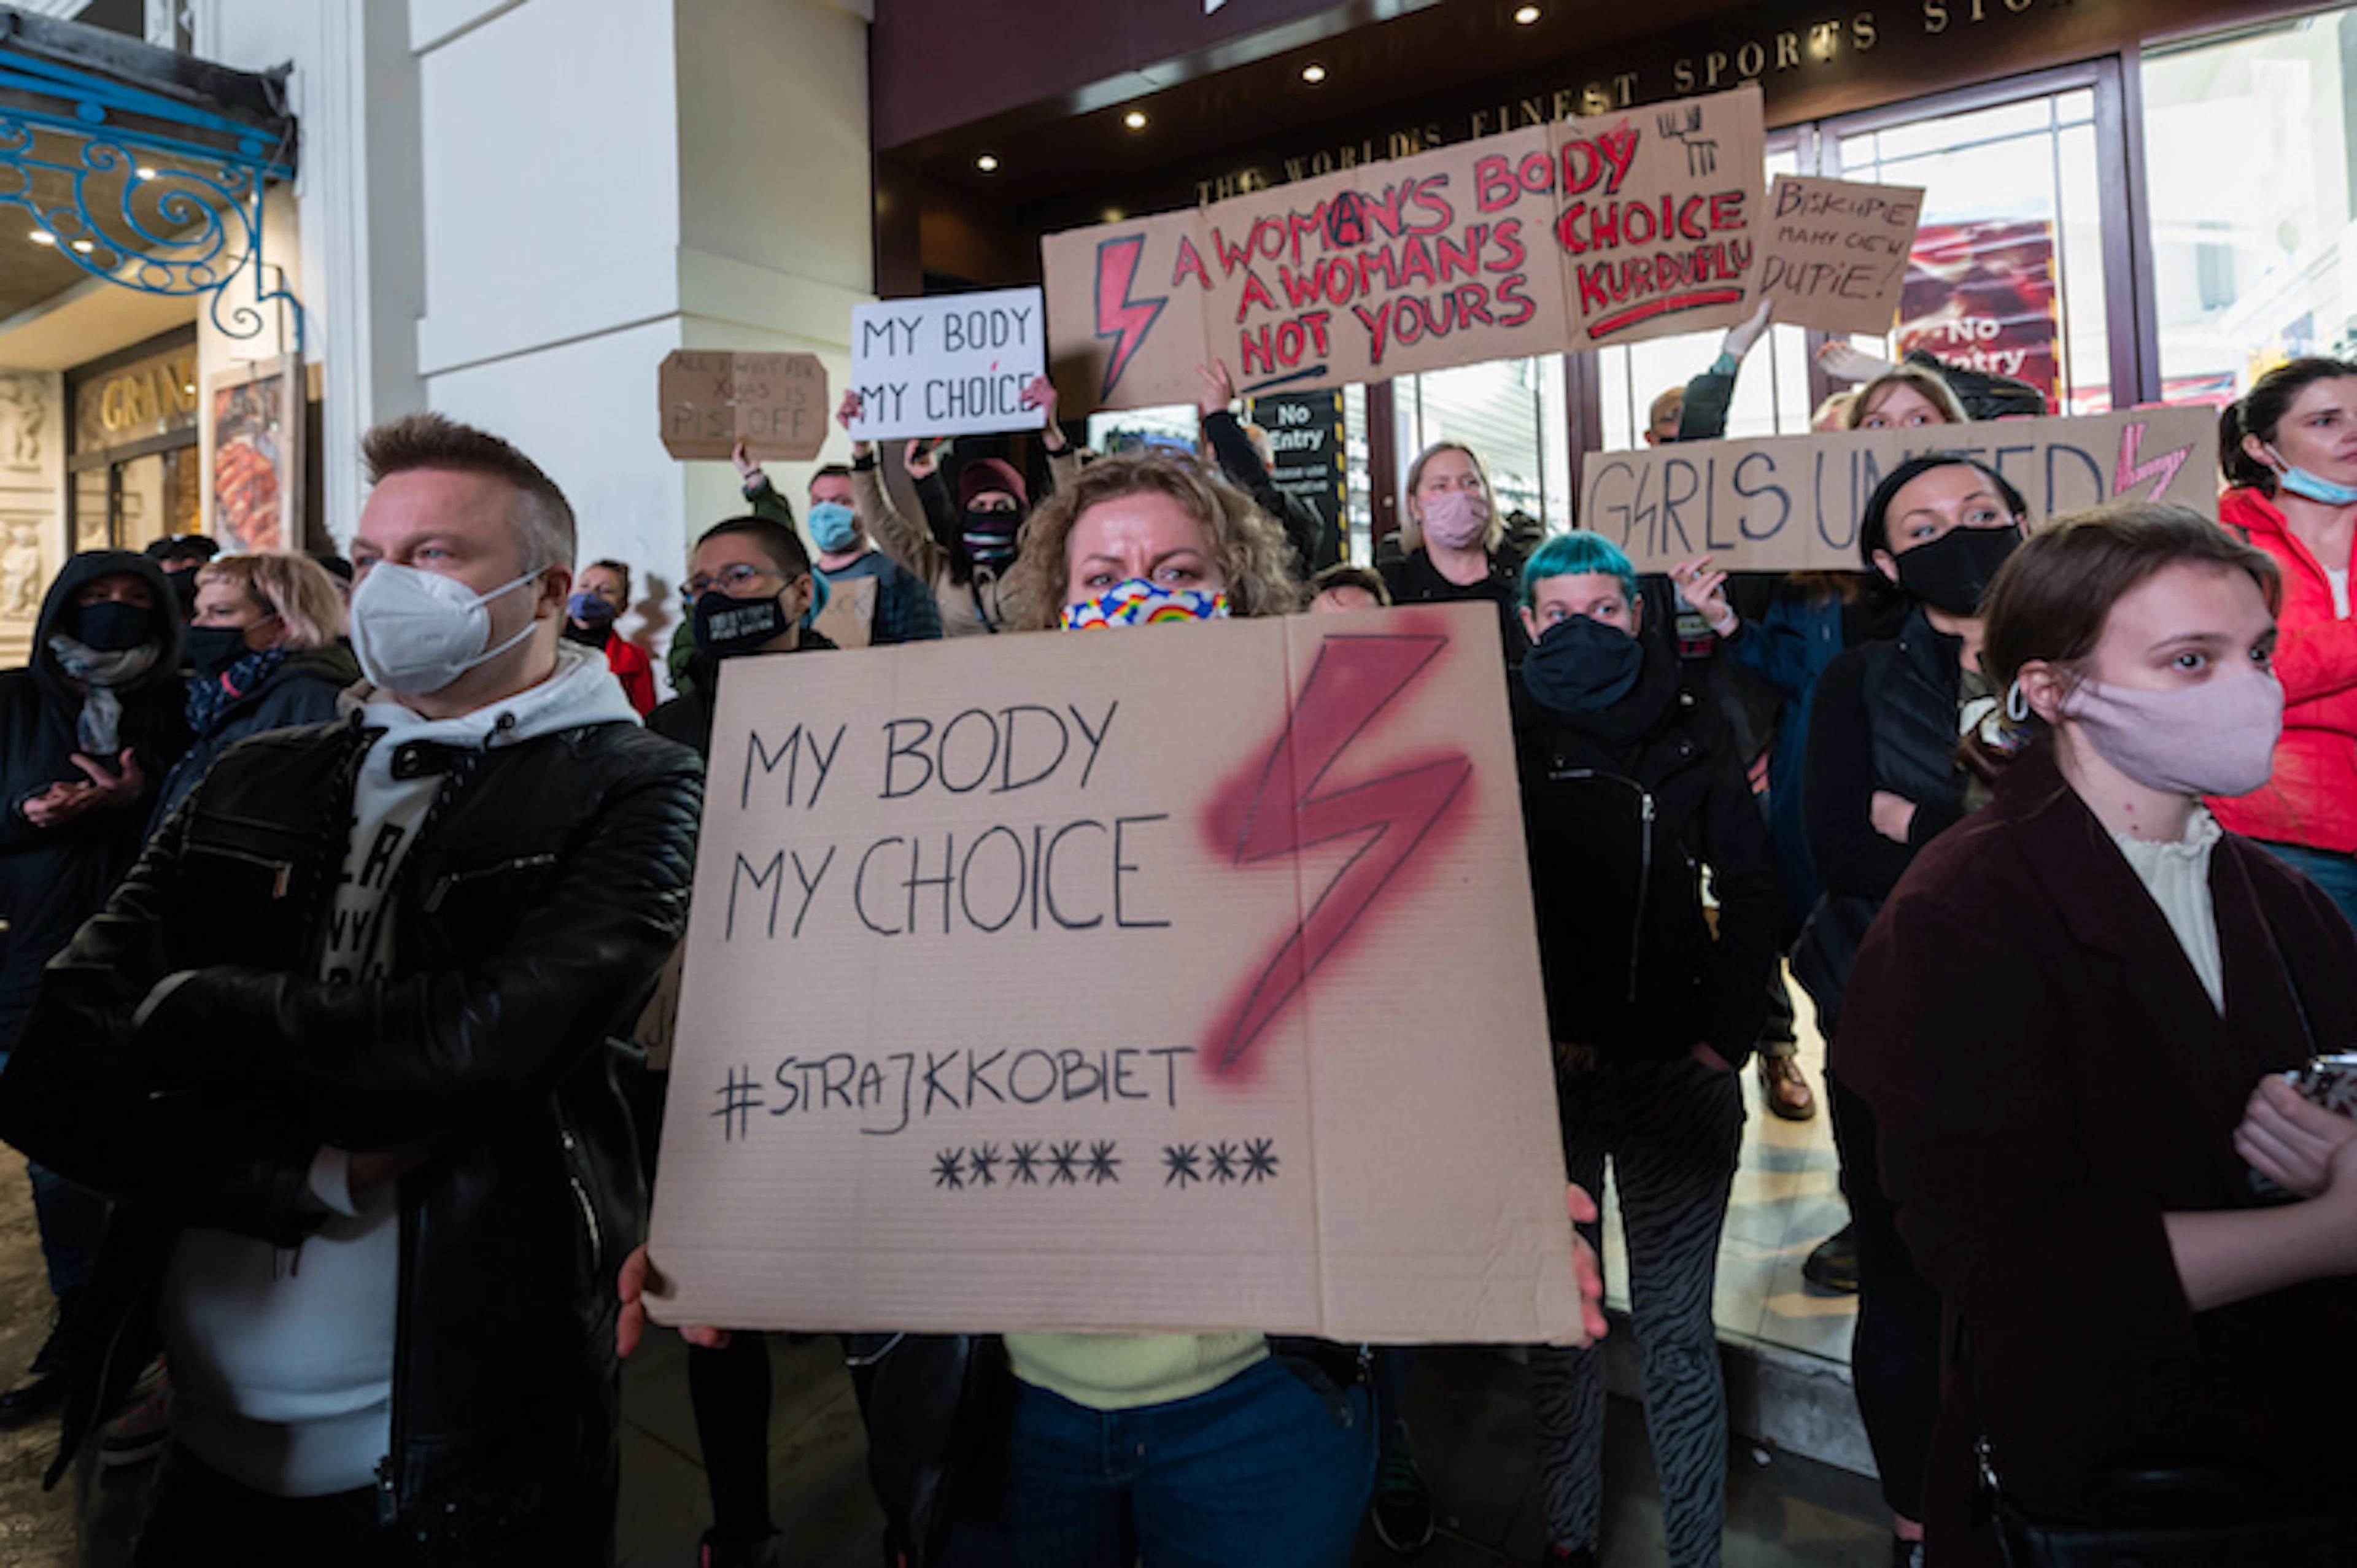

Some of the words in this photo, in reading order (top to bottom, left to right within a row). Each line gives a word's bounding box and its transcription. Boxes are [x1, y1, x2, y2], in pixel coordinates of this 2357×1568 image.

[1673, 12, 1878, 93] SPORTS
[1172, 234, 1214, 290] A
[1210, 174, 1455, 280] WOMAN'S
[1474, 119, 1641, 212] BODY
[1236, 265, 1279, 323] A
[1279, 217, 1527, 309] WOMAN'S
[1553, 189, 1747, 255] CHOICE
[862, 315, 924, 359] MY
[944, 305, 1032, 353] BODY
[1239, 309, 1331, 376] NOT
[1352, 274, 1537, 366] YOURS
[1946, 317, 2000, 343] No
[746, 407, 809, 438] OFF
[860, 382, 908, 424] MY
[925, 363, 1035, 422] CHOICE
[1277, 403, 1312, 425] No
[1269, 428, 1325, 452] Entry
[740, 722, 847, 810] MY
[878, 700, 1119, 799] BODY
[724, 844, 837, 942] MY
[854, 814, 1173, 936] CHOICE
[710, 1046, 1198, 1142] #STRAJKKOBIET
